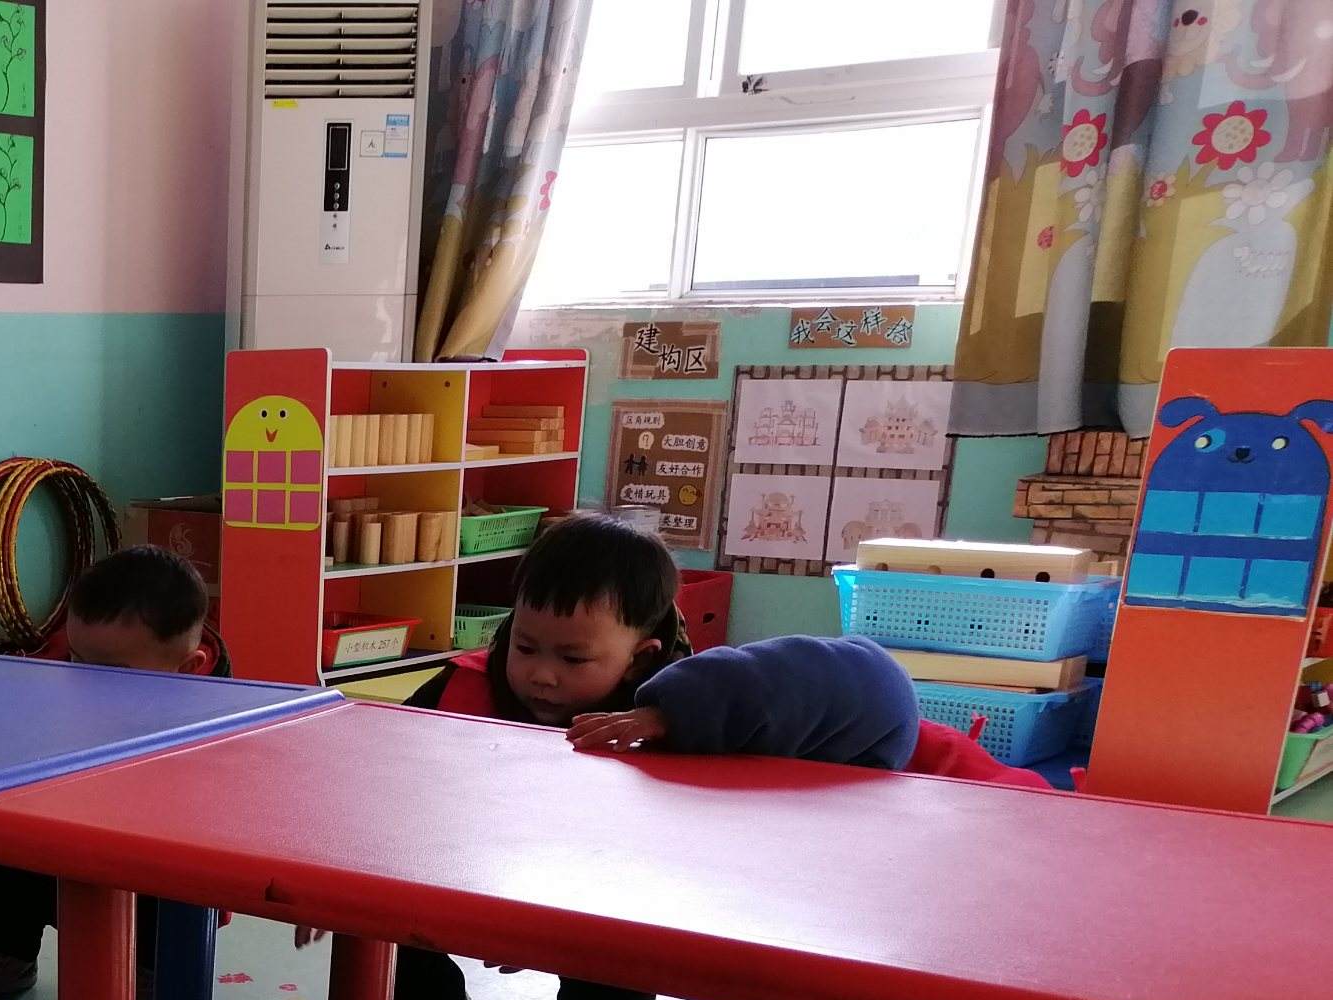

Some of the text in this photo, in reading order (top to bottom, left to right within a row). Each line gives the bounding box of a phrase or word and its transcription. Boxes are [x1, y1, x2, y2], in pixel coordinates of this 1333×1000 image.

[634, 323, 706, 373] 建构区
[663, 435, 707, 450] 大胆创意
[658, 463, 704, 476] 友好合作
[624, 486, 667, 501] 爱惜玩具
